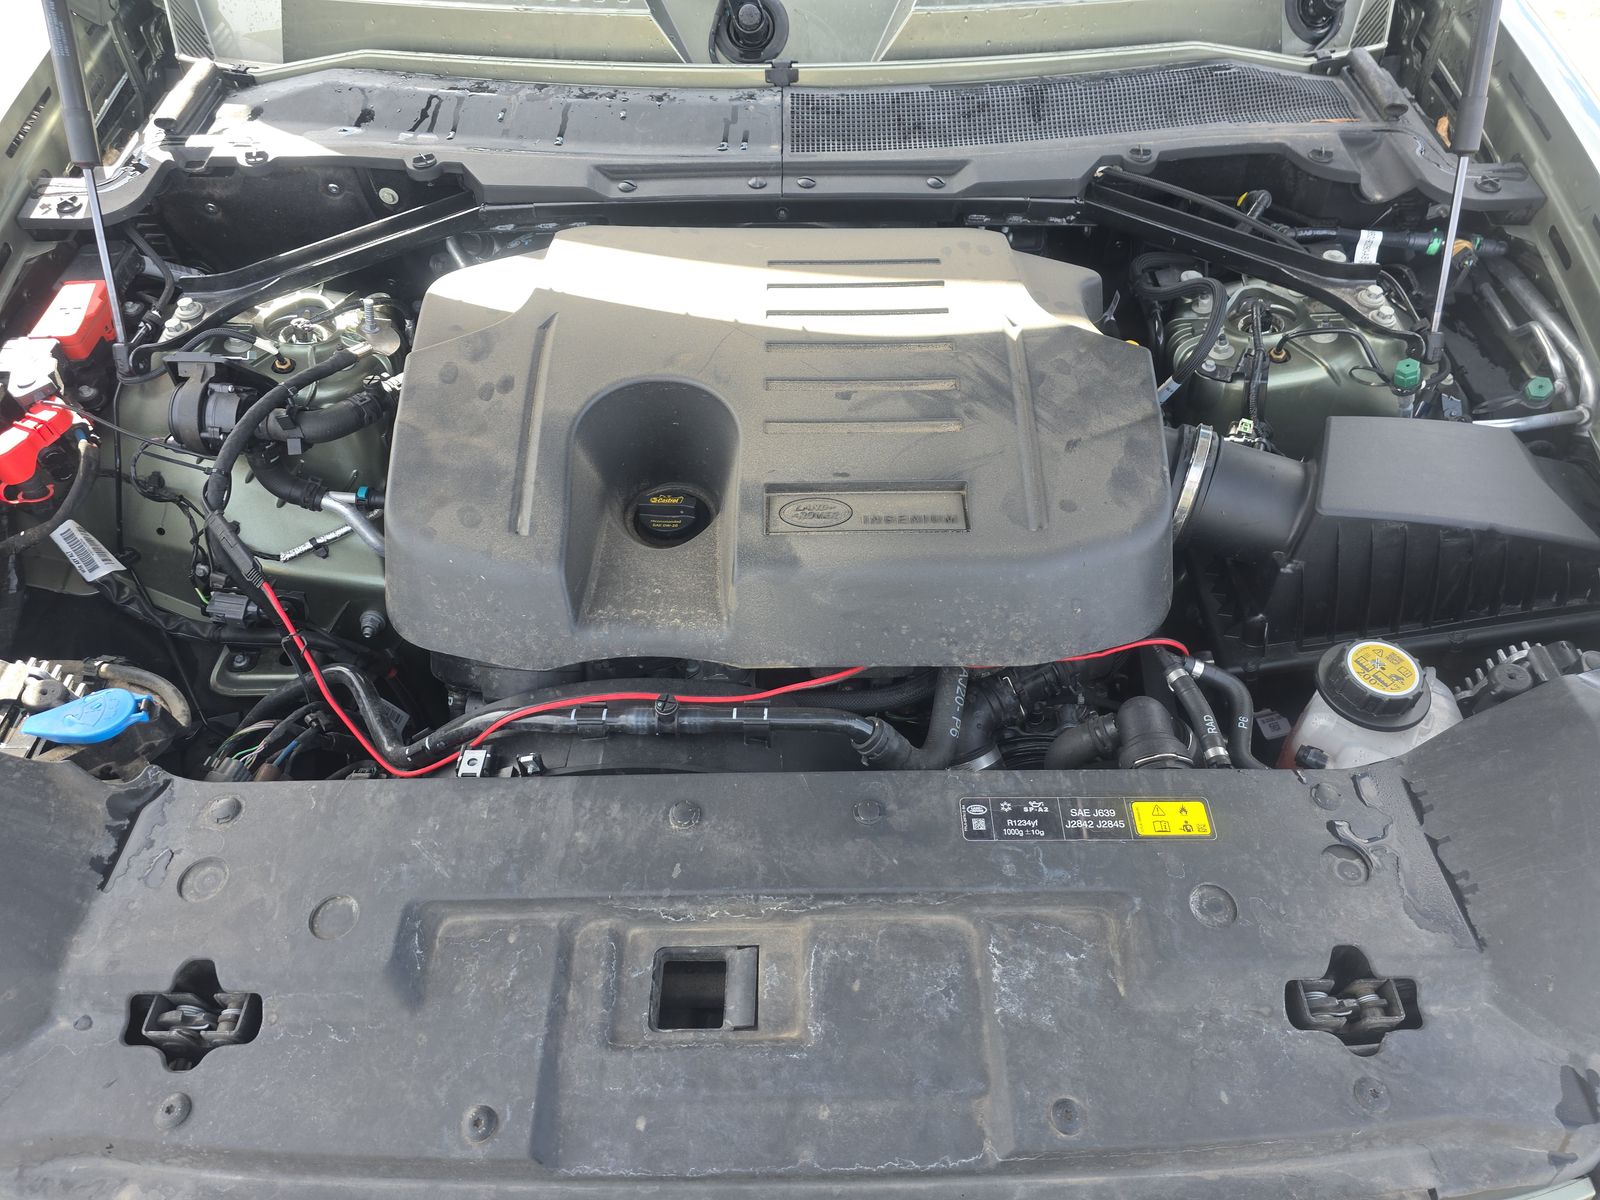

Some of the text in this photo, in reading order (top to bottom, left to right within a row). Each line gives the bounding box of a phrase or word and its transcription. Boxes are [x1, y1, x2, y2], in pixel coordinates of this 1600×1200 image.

[861, 514, 958, 525] INGENIUM
[1203, 714, 1219, 734] RAD
[1070, 808, 1116, 817] SAE J639
[1007, 819, 1039, 828] R1234yf
[1065, 820, 1125, 829] J2842 J2845
[1003, 828, 1024, 837] 1000g
